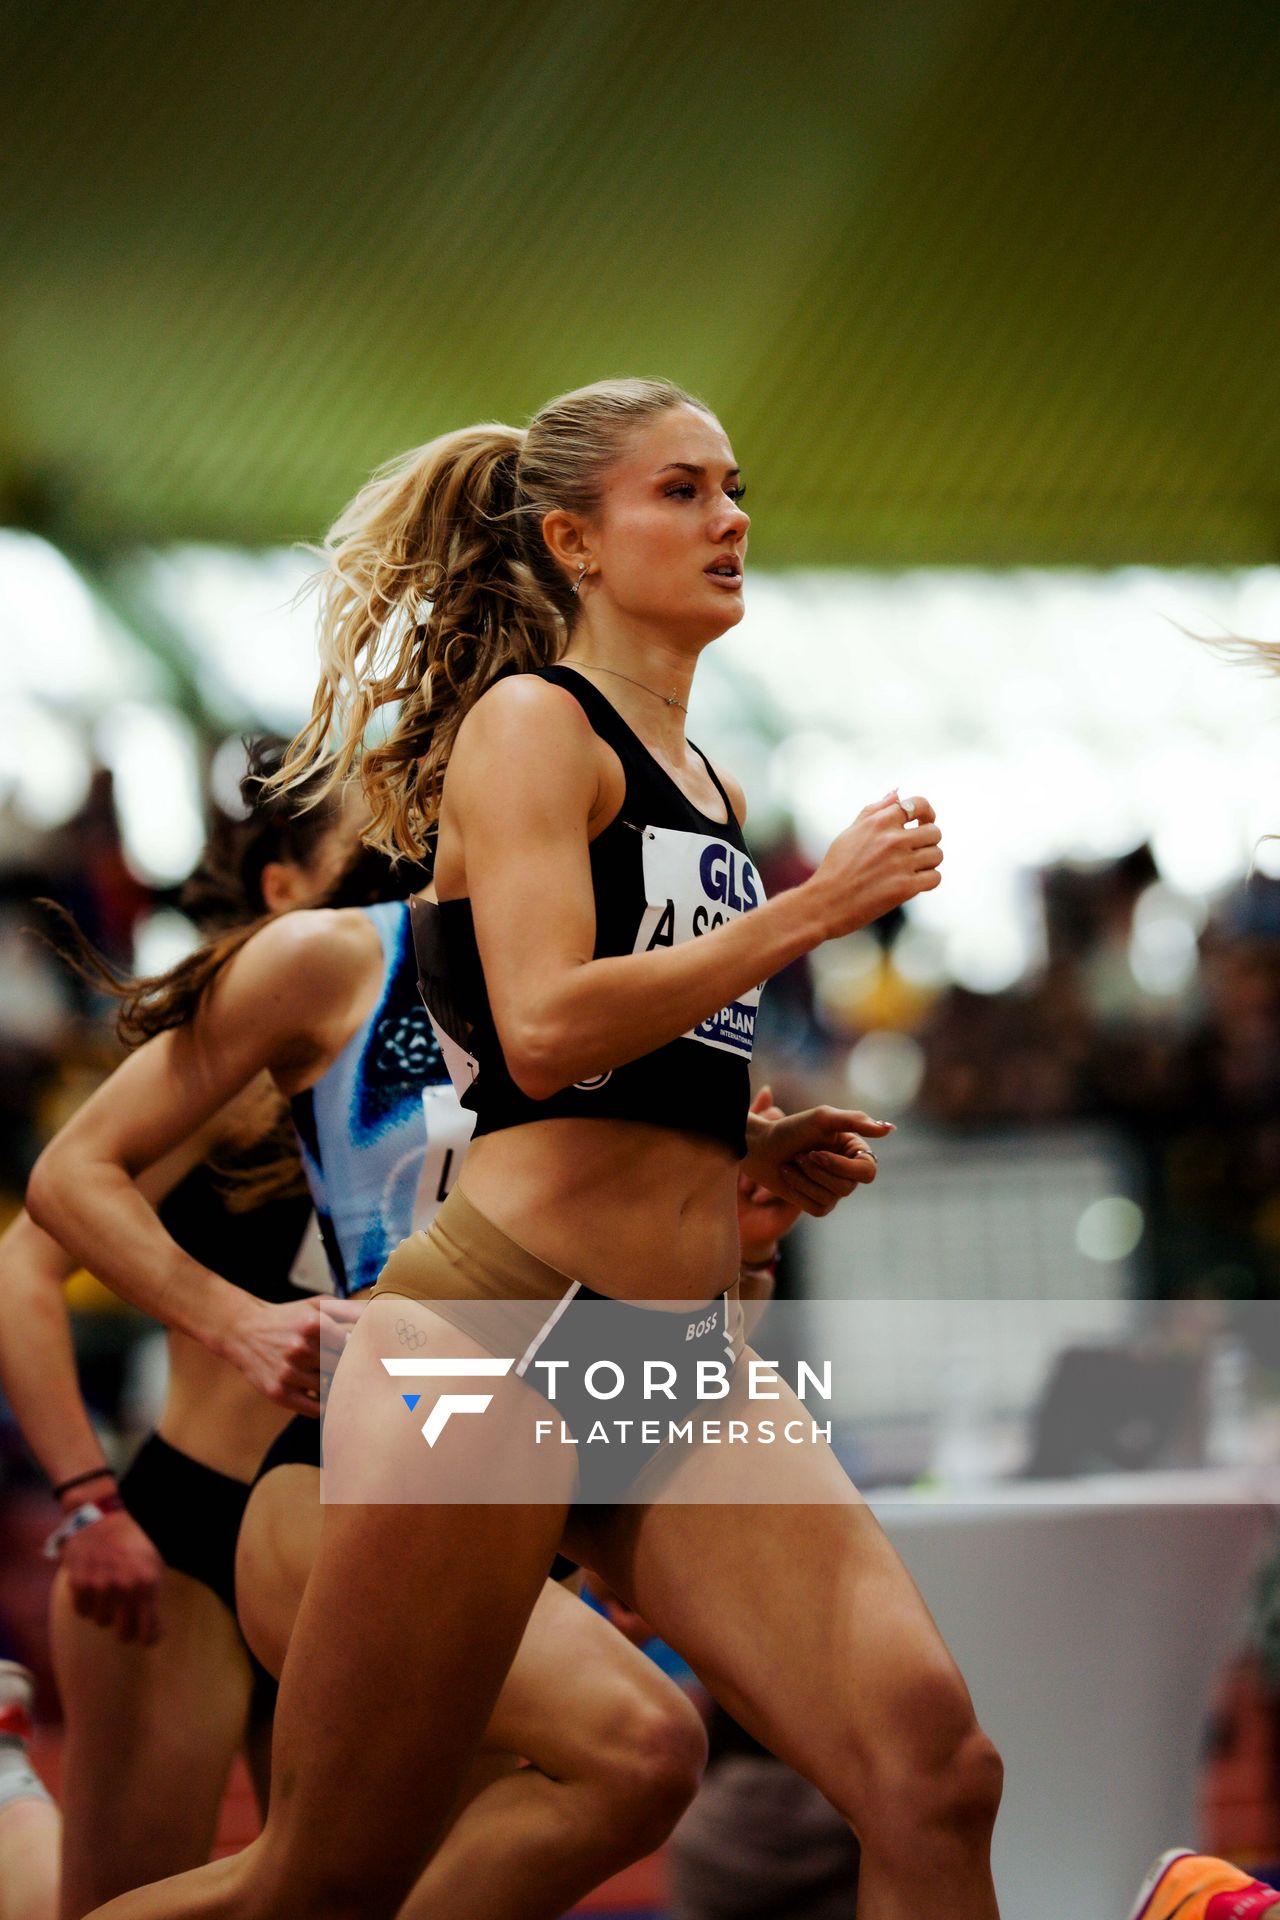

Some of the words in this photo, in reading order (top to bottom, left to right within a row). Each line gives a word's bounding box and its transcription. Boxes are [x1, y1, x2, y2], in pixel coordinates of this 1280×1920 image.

[699, 843, 758, 913] GLS
[720, 1007, 754, 1036] PLAN
[685, 1312, 718, 1342] BOSS
